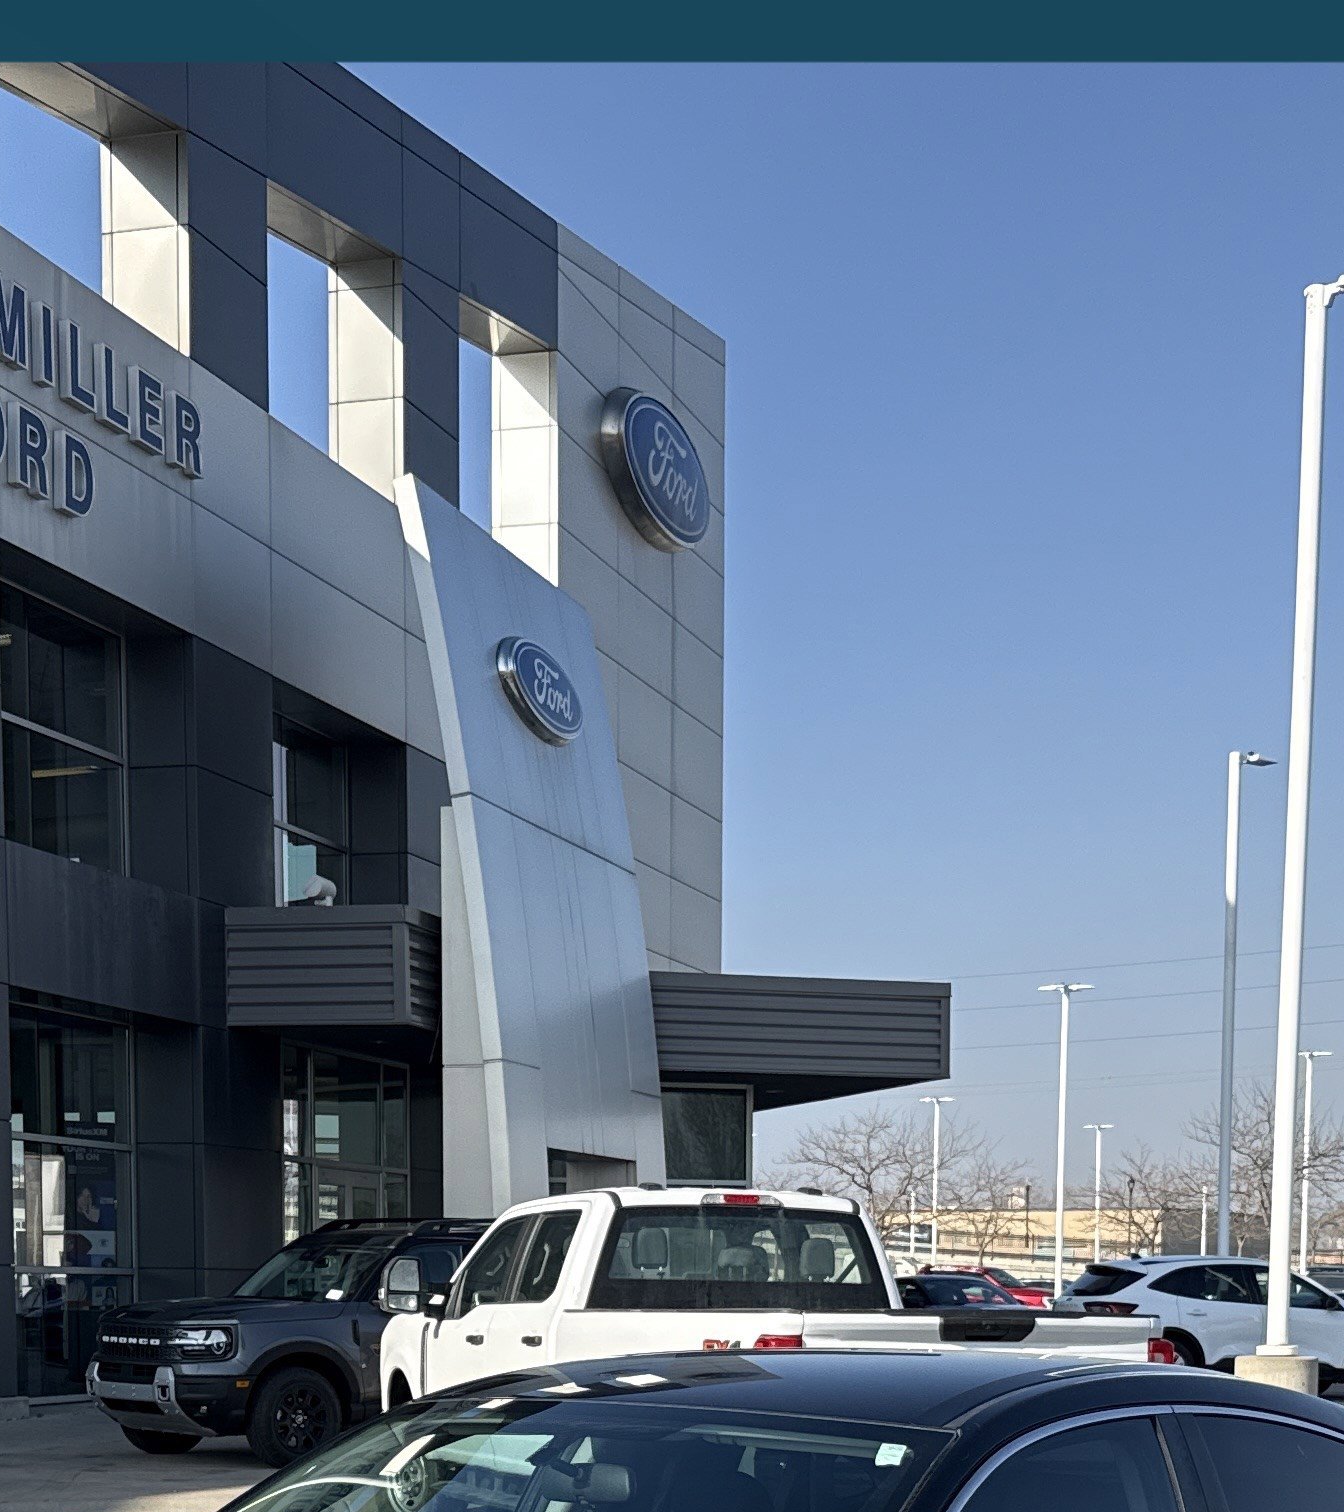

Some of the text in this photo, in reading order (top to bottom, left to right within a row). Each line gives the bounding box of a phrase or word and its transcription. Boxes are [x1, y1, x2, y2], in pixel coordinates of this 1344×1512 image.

[647, 420, 699, 522] Ford
[533, 658, 573, 721] Ford
[101, 1334, 161, 1346] BRONCO
